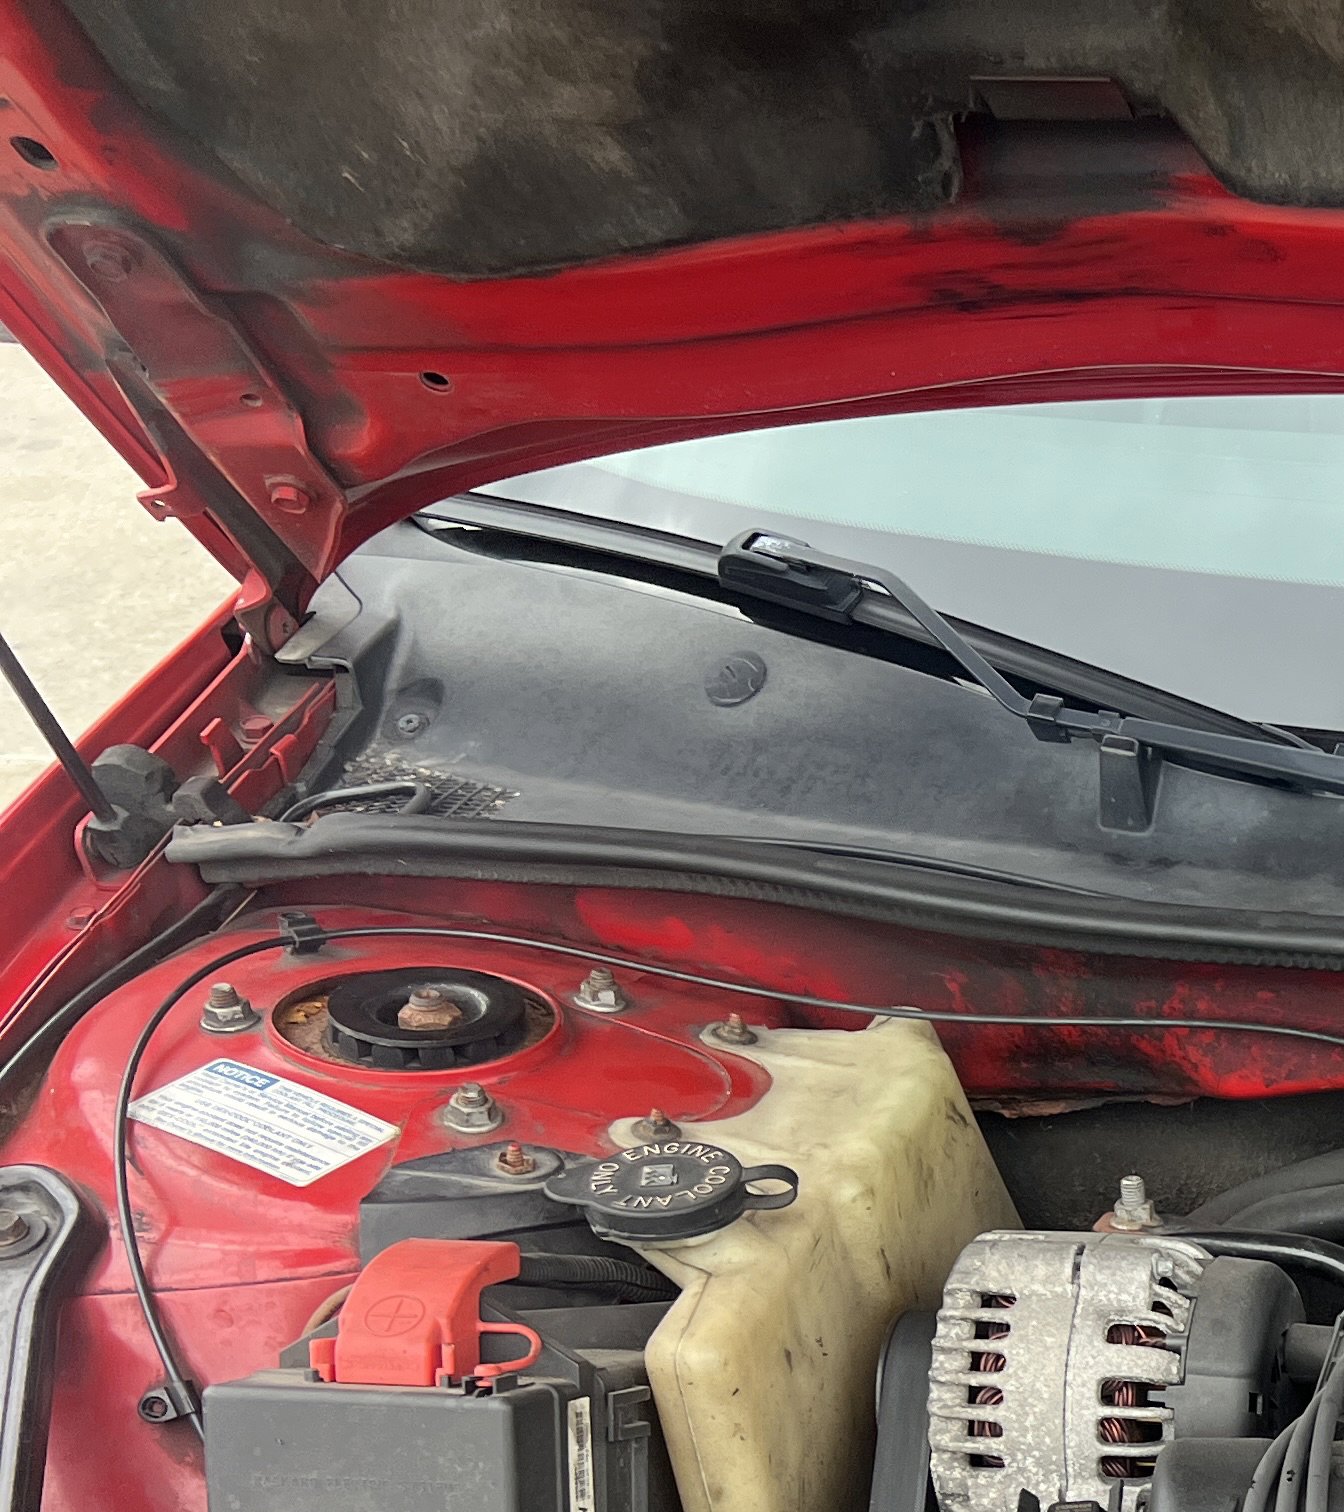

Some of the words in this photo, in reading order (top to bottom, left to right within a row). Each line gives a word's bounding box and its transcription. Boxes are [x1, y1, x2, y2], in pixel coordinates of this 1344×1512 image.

[216, 1063, 270, 1088] NOTICE
[622, 1142, 722, 1163] ENGINE
[591, 1162, 619, 1195] ONLY
[612, 1165, 730, 1208] COOLANT
